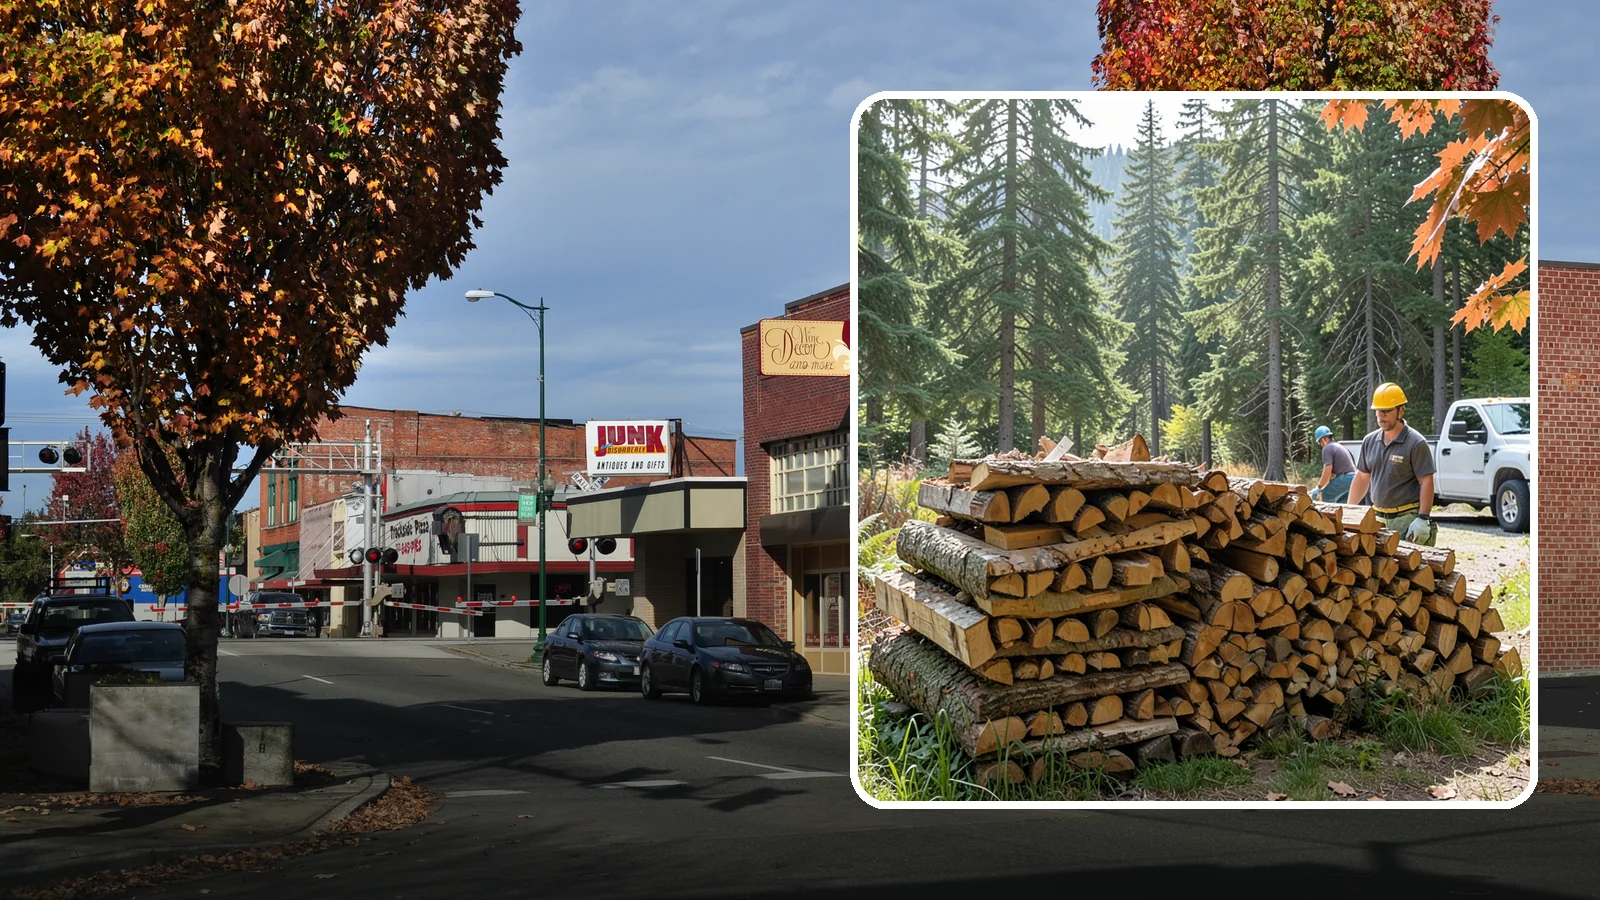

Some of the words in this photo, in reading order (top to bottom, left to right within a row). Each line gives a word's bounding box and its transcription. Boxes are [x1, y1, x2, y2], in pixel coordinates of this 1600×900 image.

[765, 328, 831, 365] Decor
[595, 425, 665, 457] JUNK
[607, 446, 646, 454] DISORDERLY
[597, 461, 628, 470] ANTIQUES
[631, 461, 644, 470] AND
[647, 460, 665, 470] GIFTS
[390, 521, 413, 540] Trackside
[414, 519, 429, 535] Pizza
